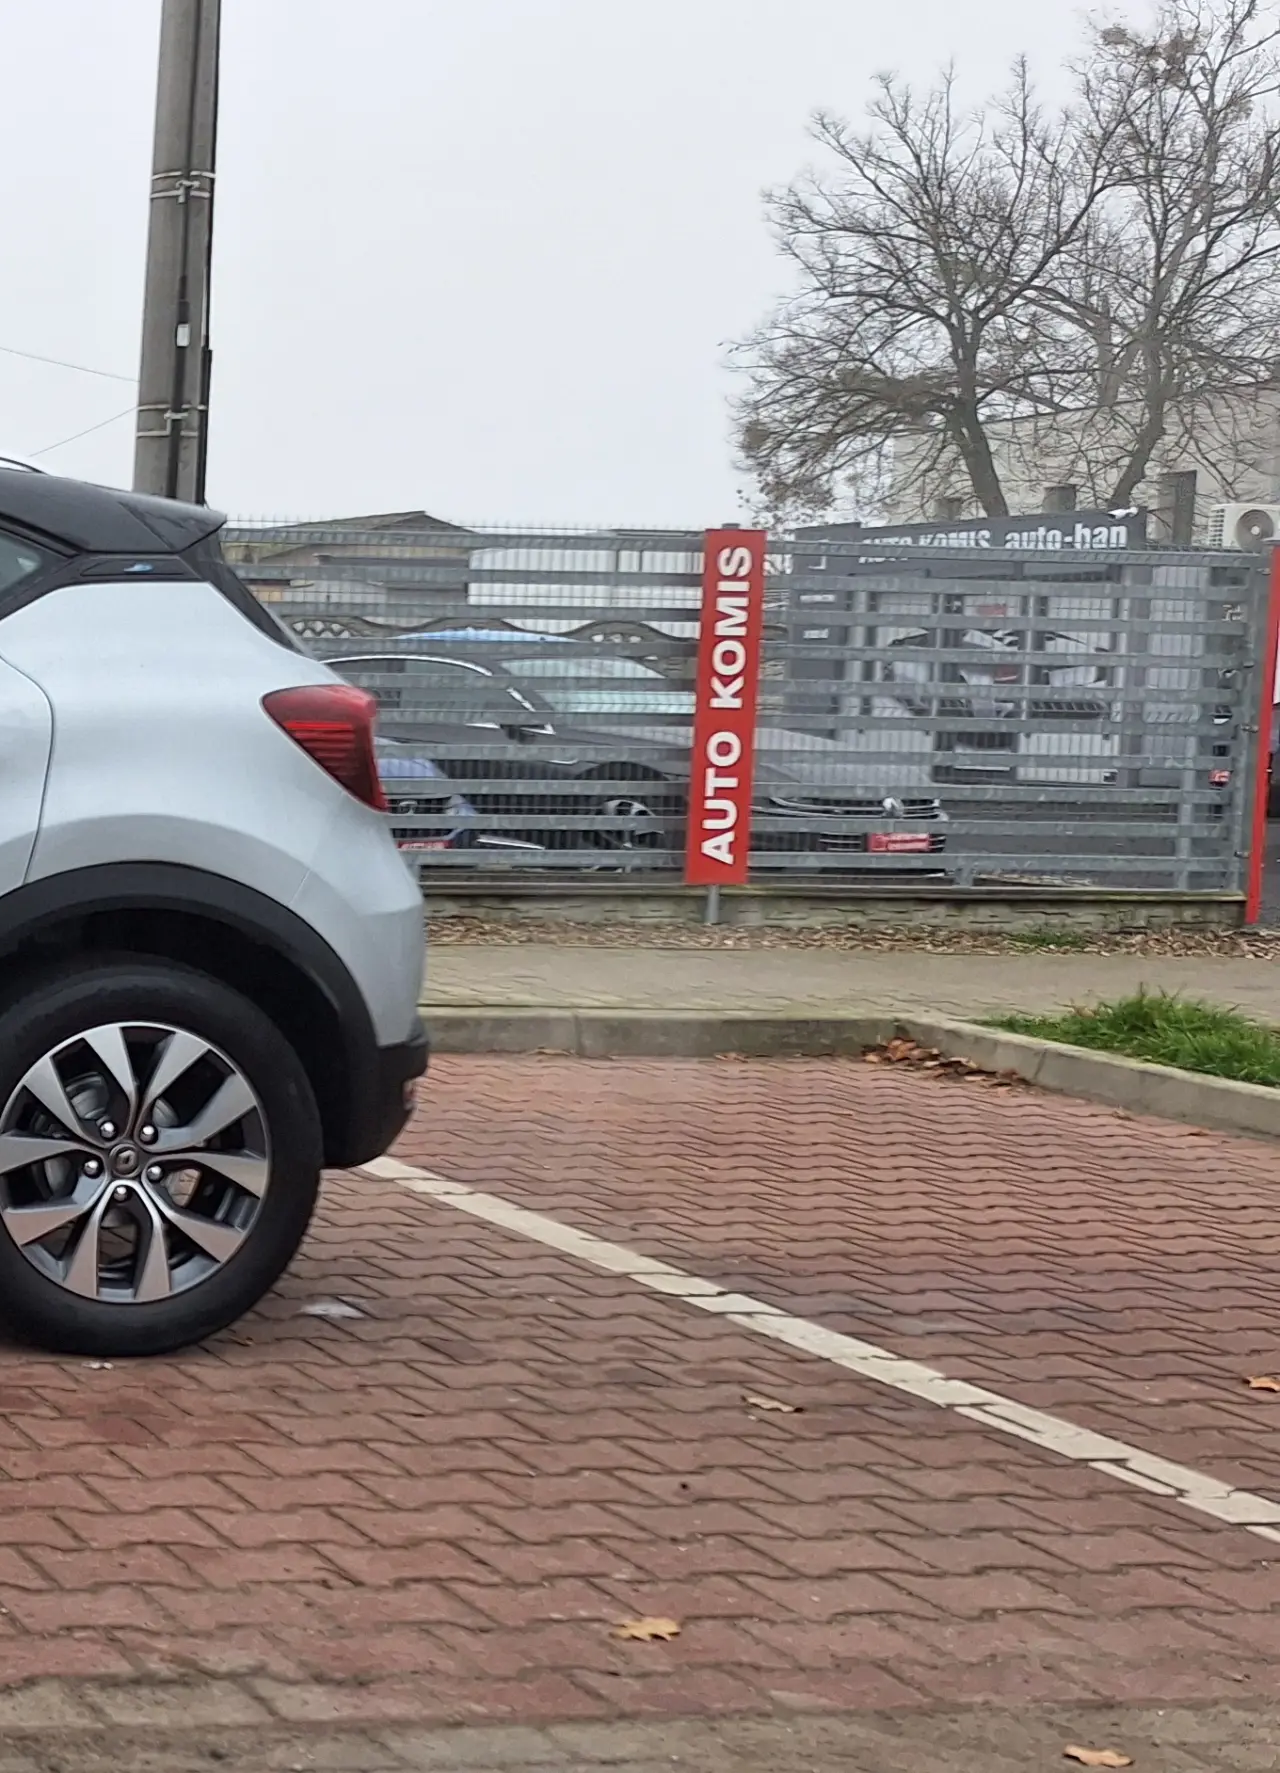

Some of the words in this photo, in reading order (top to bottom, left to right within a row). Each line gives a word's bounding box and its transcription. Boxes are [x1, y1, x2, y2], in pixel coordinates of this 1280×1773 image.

[1004, 523, 1127, 550] auto-han
[709, 545, 754, 709] KOMIS
[701, 730, 742, 865] AUTO
